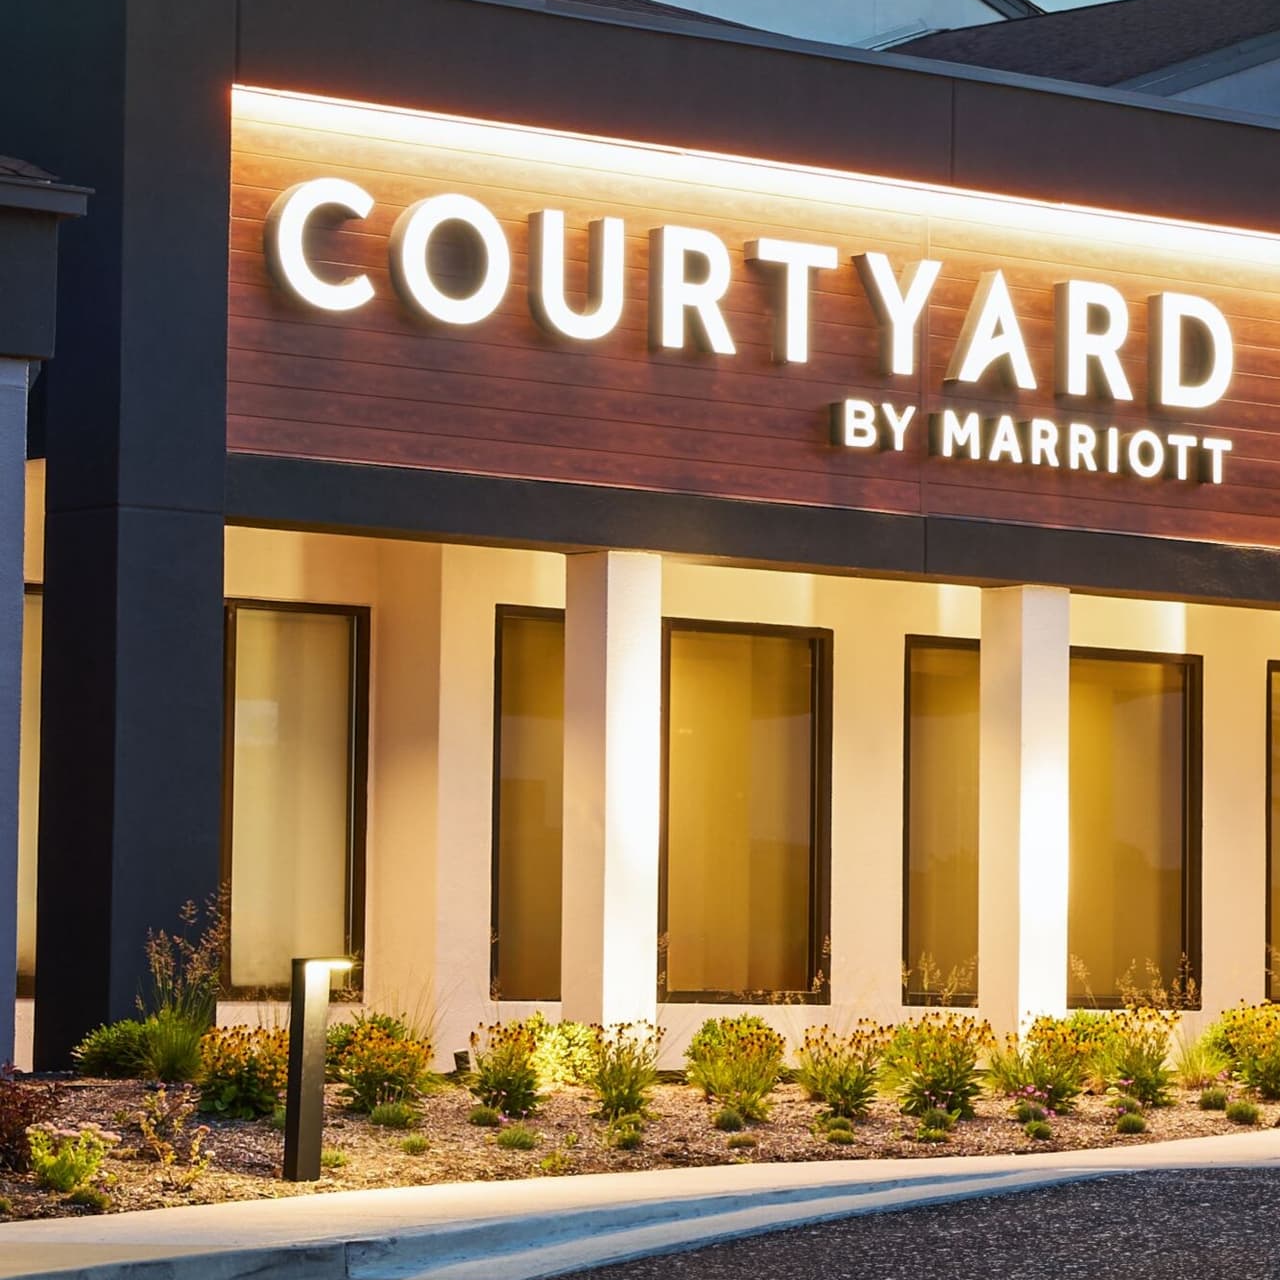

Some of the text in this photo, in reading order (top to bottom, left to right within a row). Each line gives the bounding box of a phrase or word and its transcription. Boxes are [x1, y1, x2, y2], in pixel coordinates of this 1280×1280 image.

[270, 177, 1234, 409] COURTYARD
[841, 399, 1232, 484] BY MARRIOTT
